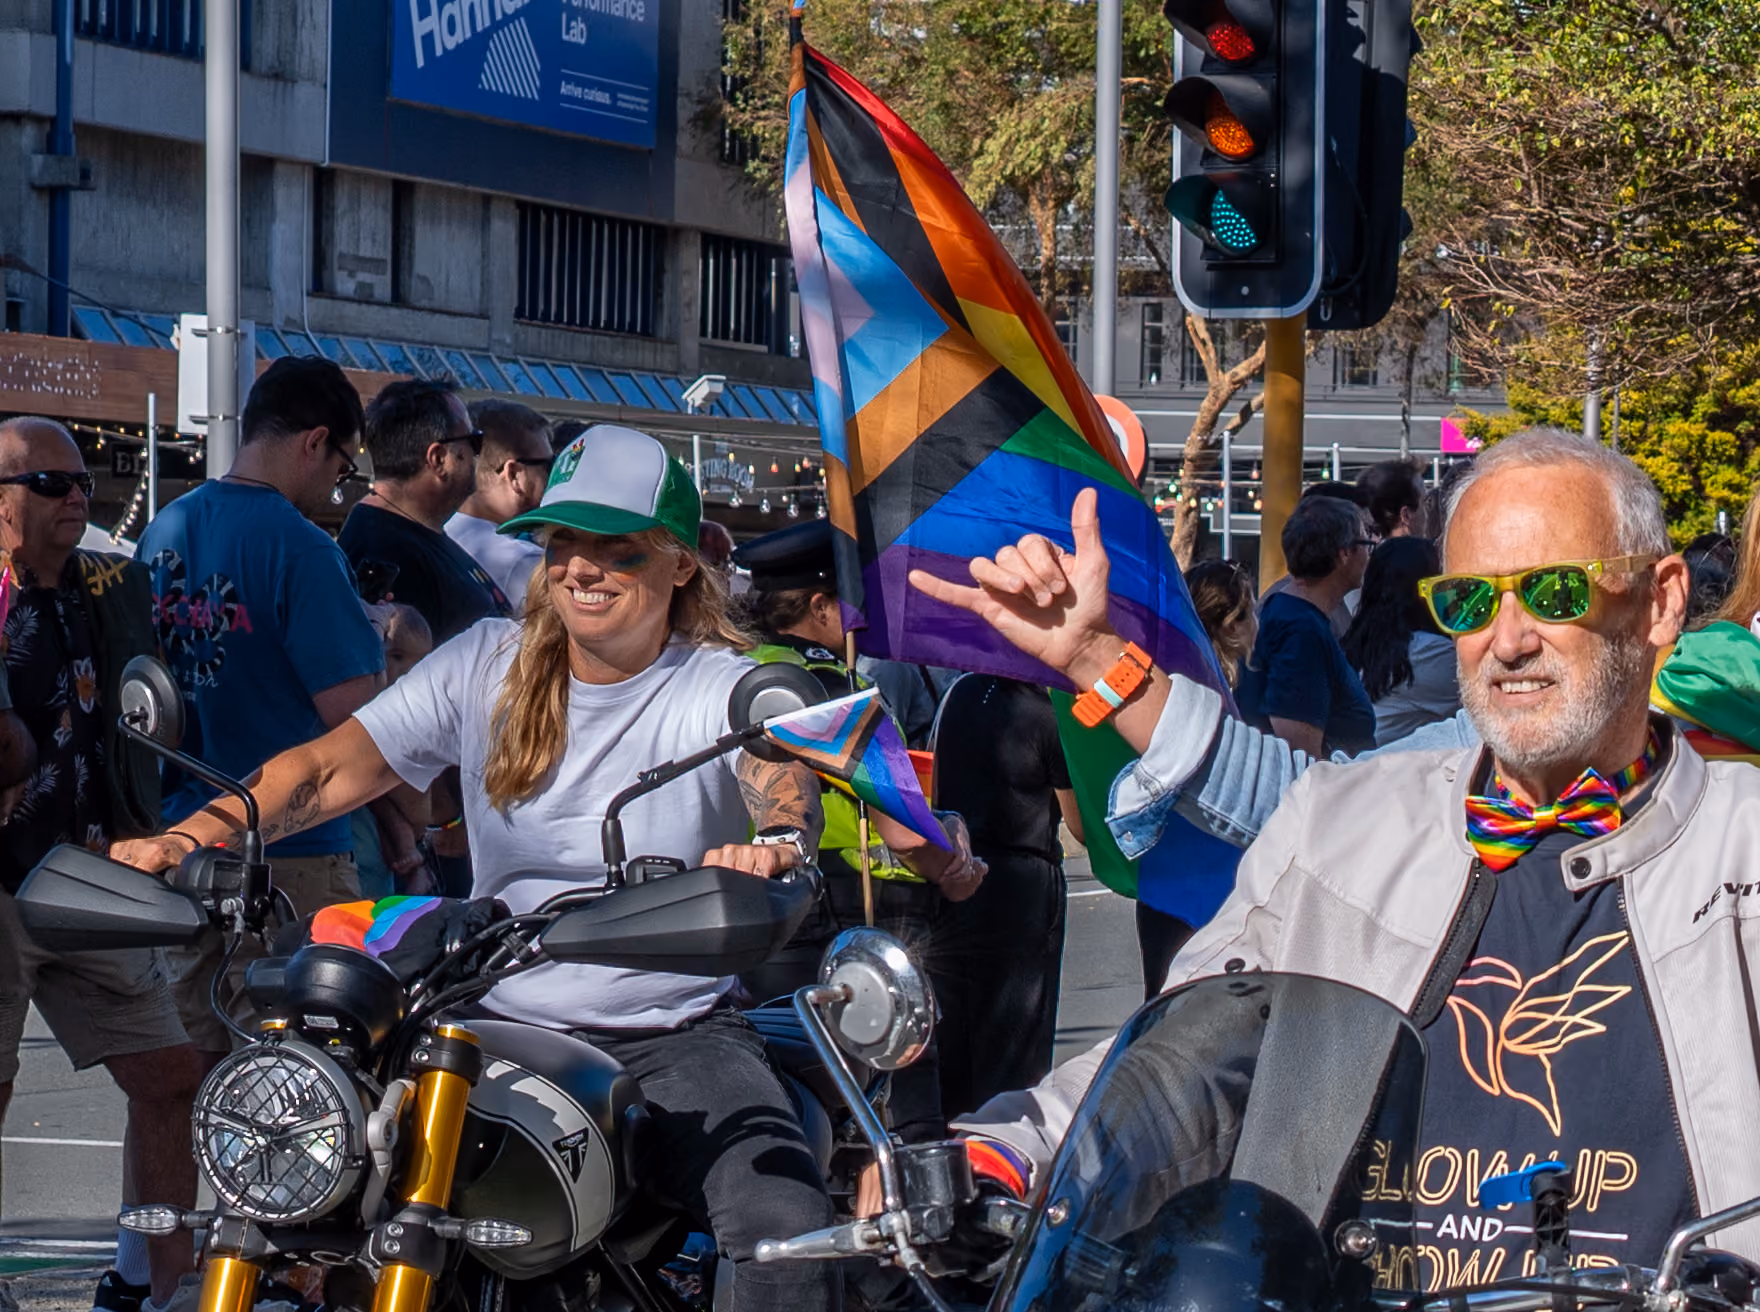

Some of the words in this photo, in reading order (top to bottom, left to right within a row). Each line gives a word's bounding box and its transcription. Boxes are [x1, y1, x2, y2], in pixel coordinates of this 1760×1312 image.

[408, 0, 531, 69] Hann
[561, 12, 588, 45] Lab
[1353, 1139, 1538, 1210] GLOW
[1436, 1213, 1504, 1243] AND
[1369, 1245, 1506, 1293] HOW
